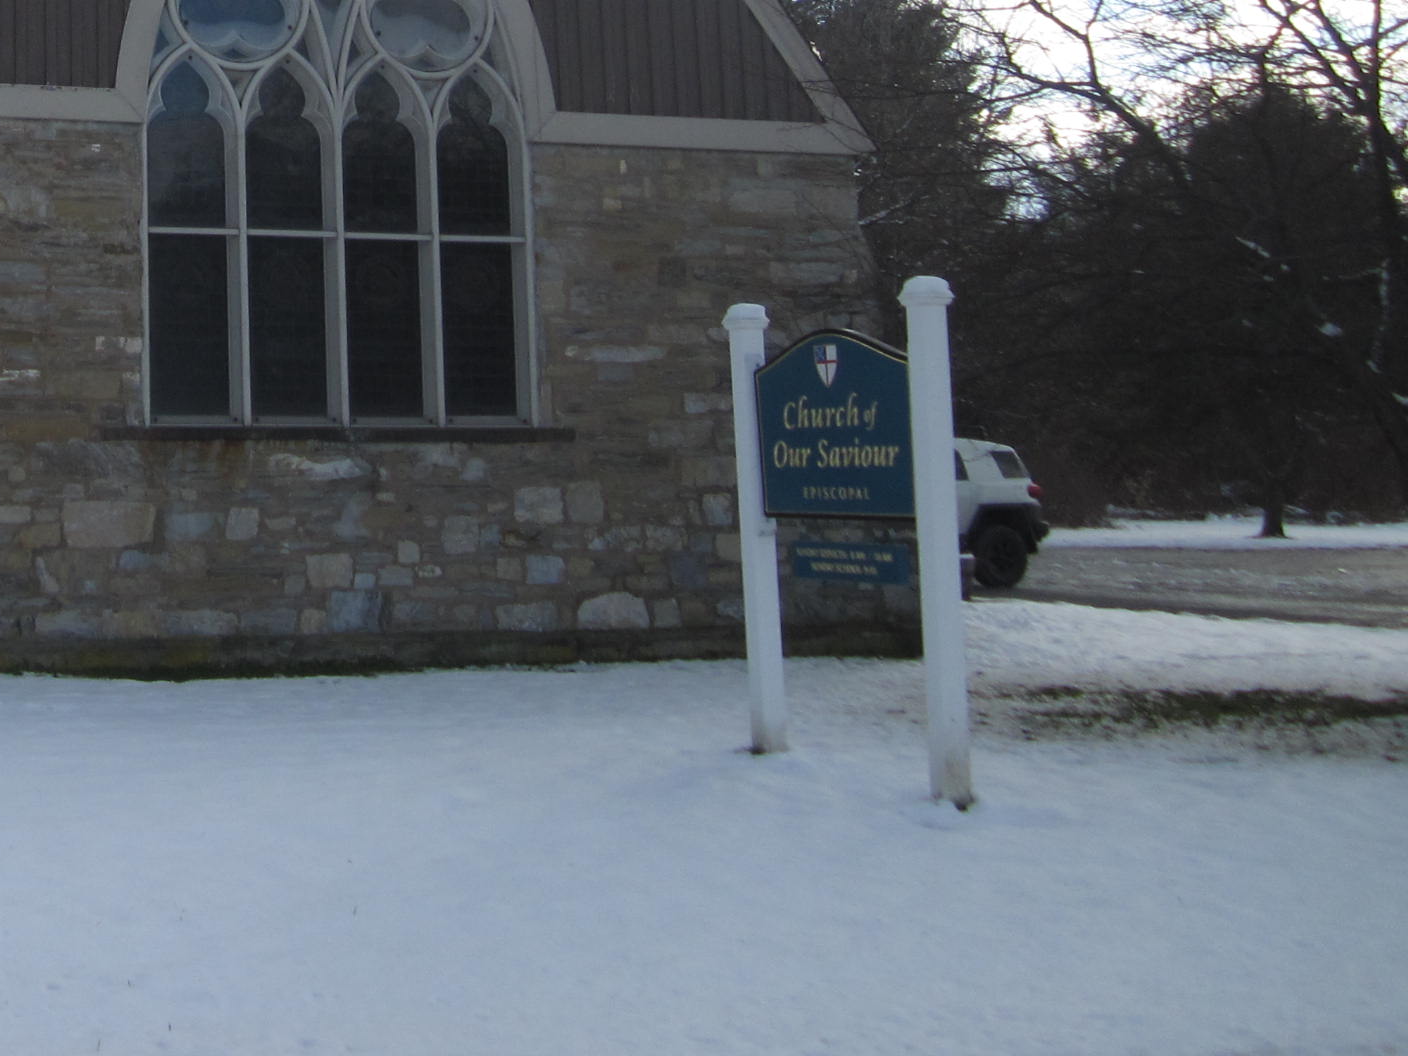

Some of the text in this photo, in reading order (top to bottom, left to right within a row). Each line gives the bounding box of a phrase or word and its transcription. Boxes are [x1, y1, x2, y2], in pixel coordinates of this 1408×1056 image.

[783, 392, 878, 430] Church of
[774, 437, 899, 468] Our Saviour
[803, 486, 870, 500] EPISCOPAL
